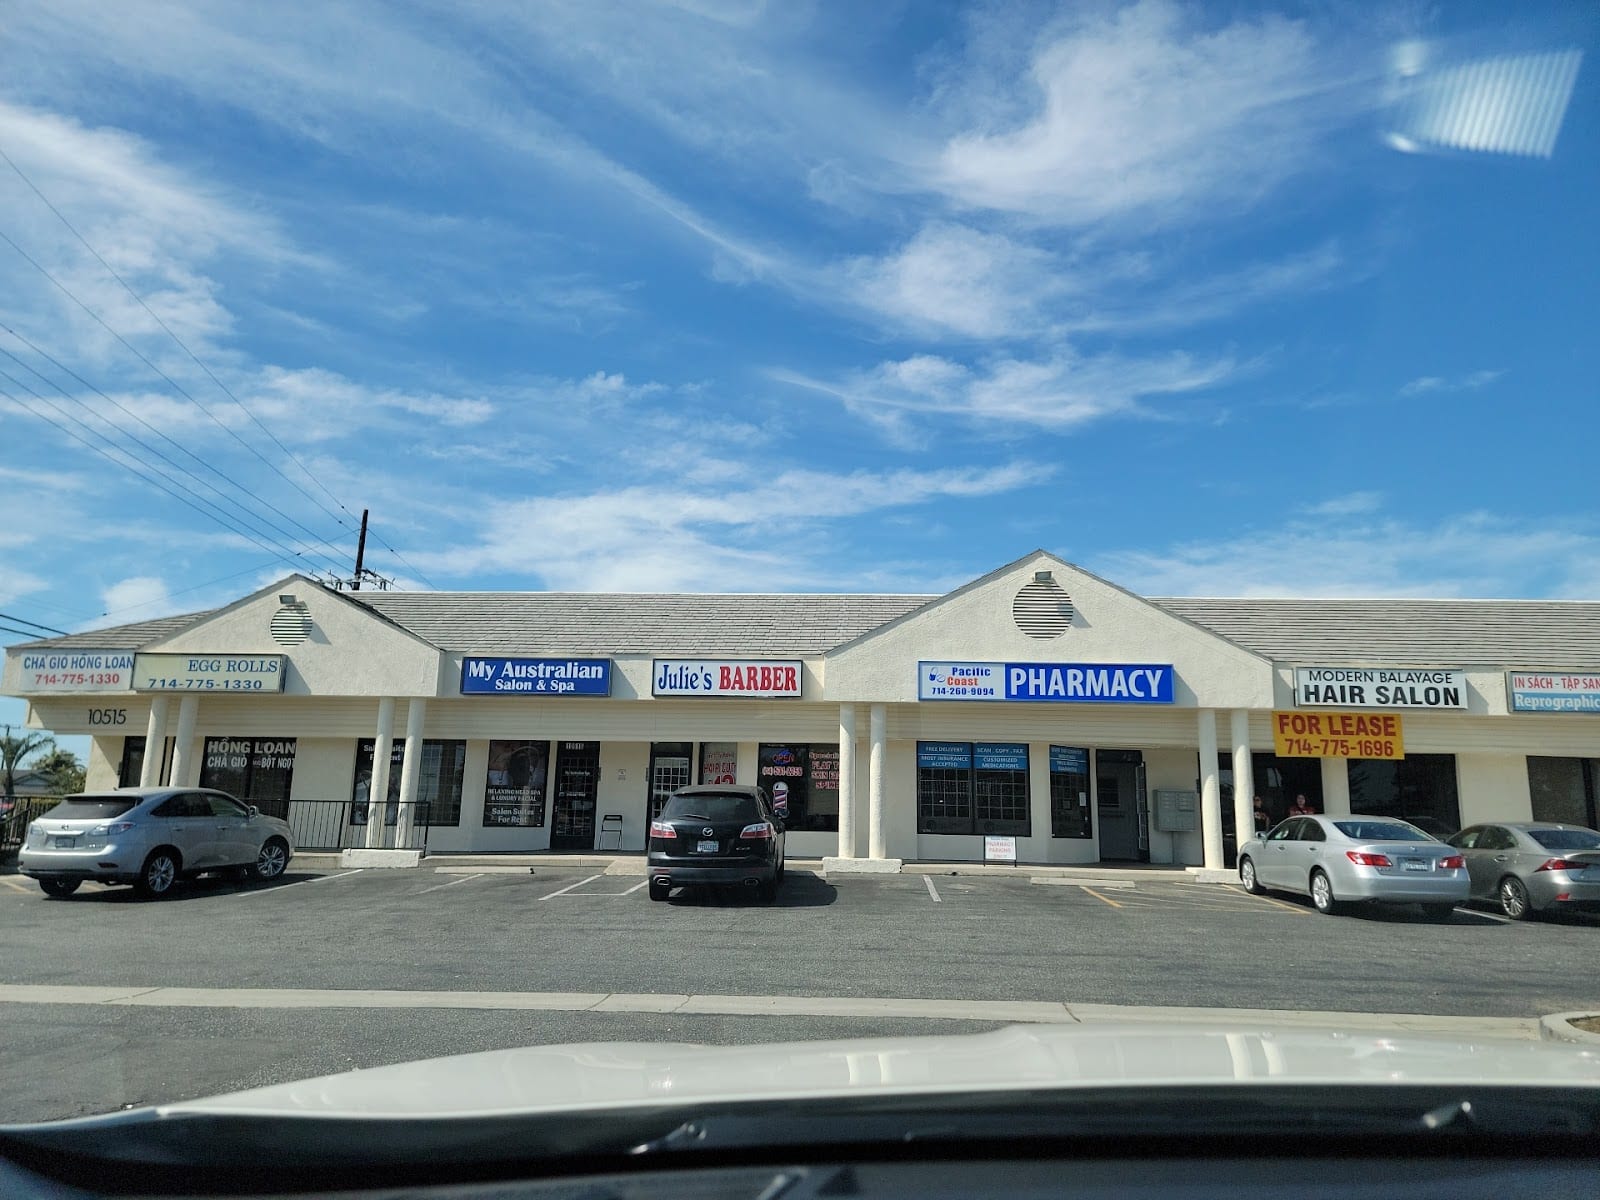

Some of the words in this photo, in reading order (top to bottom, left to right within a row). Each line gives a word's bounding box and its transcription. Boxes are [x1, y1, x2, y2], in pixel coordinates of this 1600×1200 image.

[188, 659, 221, 672] EGG
[226, 660, 278, 673] ROLLS
[469, 661, 496, 680] My
[501, 661, 603, 679] Australian
[952, 667, 991, 676] Pacific
[35, 673, 120, 685] 714-775-1330
[148, 679, 262, 689] 714-775-1330
[658, 665, 712, 691] Julie's
[719, 666, 797, 691] BARBER
[947, 677, 978, 686] Coast
[1010, 668, 1163, 697] PHARMACY
[1309, 671, 1374, 682] MODERN
[1380, 673, 1453, 684] BALAYAGE
[1514, 677, 1525, 688] IN
[495, 679, 532, 690] Salon
[536, 680, 546, 691] &
[550, 680, 575, 693] Spa
[932, 687, 994, 696] 714-260-9094
[1304, 684, 1366, 704] HAIR
[1375, 686, 1460, 706] SALON
[88, 709, 127, 725] 10515
[1278, 714, 1322, 734] FOR
[1328, 716, 1397, 737] LEASE
[254, 742, 296, 754] LOAN
[1285, 738, 1394, 757] 714-775-1696
[772, 753, 796, 763] OPEN
